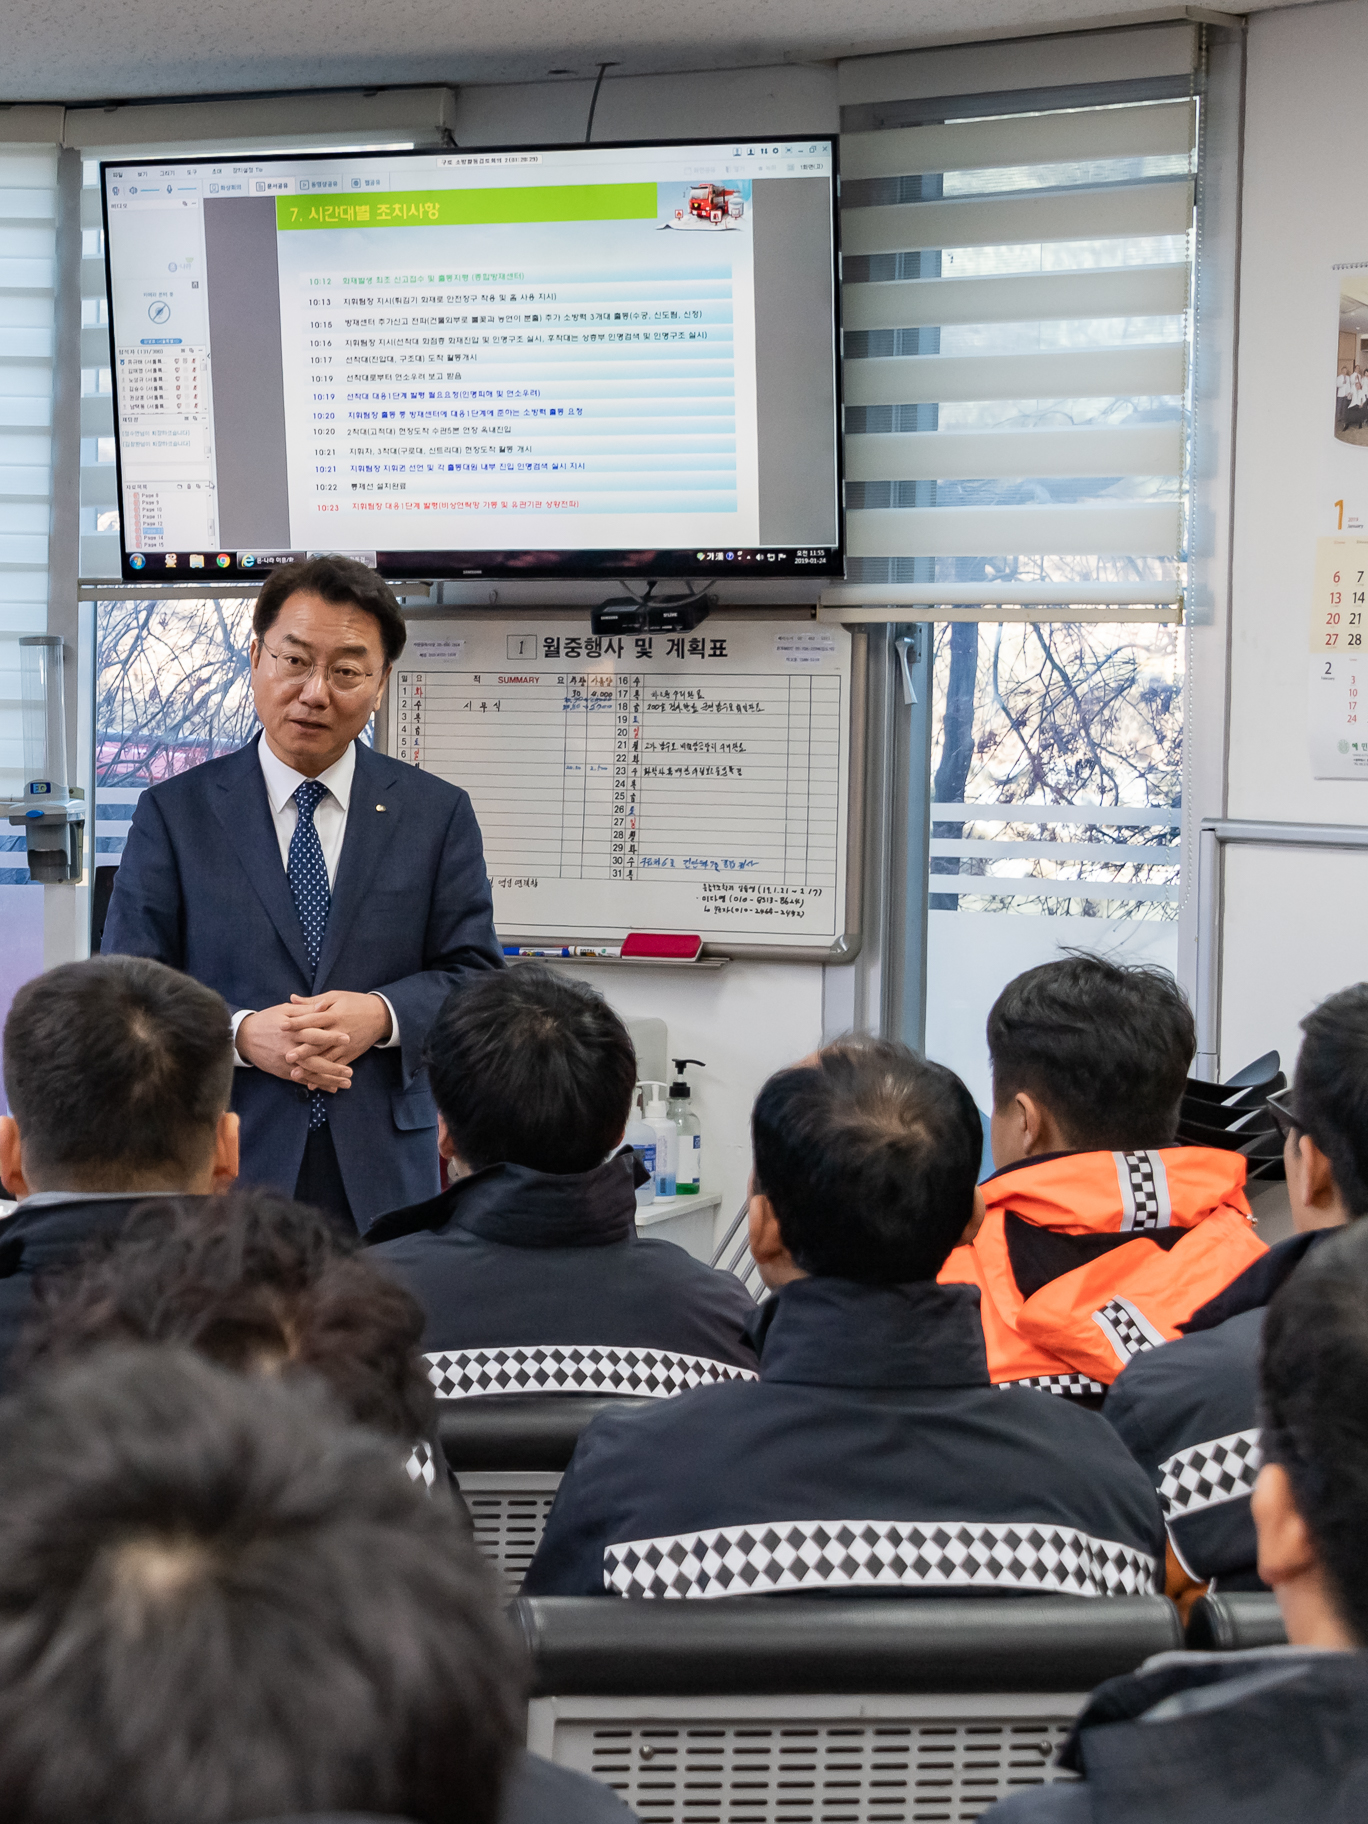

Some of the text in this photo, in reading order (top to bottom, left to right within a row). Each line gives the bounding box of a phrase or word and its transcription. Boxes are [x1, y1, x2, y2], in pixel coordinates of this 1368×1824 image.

[290, 202, 440, 222] 7. 시간대별 조치사항
[309, 278, 331, 286] 10:12
[309, 298, 330, 306] 10:13
[314, 448, 335, 456] 10:21
[1334, 499, 1344, 530] 1
[1333, 570, 1364, 584] 6 7
[1330, 592, 1365, 604] 13 14
[1325, 612, 1362, 625] 20 21
[1325, 633, 1362, 646] 27 28
[543, 637, 728, 659] 월중행사 및 계획표
[1324, 661, 1332, 675] 2
[473, 675, 481, 684] 적
[497, 676, 540, 684] SUMMARY
[557, 676, 564, 684] 요
[618, 677, 628, 685] 16
[1351, 676, 1356, 685] 3
[403, 687, 406, 695] 1
[618, 690, 628, 699] 17
[1349, 688, 1358, 698] 10
[402, 700, 407, 708] 2
[414, 700, 422, 711] 수
[463, 700, 471, 711] 시
[493, 700, 500, 712] 식
[618, 703, 628, 711] 18
[1348, 701, 1357, 710] 17
[402, 713, 406, 721] 3
[617, 716, 628, 724] 19
[1347, 714, 1357, 723] 24
[401, 725, 406, 733] 4
[617, 728, 628, 737] 20
[617, 741, 628, 749] 21
[401, 750, 406, 758] 6
[616, 754, 627, 762] 22
[615, 767, 626, 775] 23
[615, 780, 626, 788] 24
[614, 792, 625, 800] 25
[614, 805, 624, 813] 26
[613, 818, 624, 826] 27
[613, 831, 624, 839] 28
[613, 844, 623, 852] 29
[612, 857, 623, 865] 30
[612, 869, 622, 877] 31
